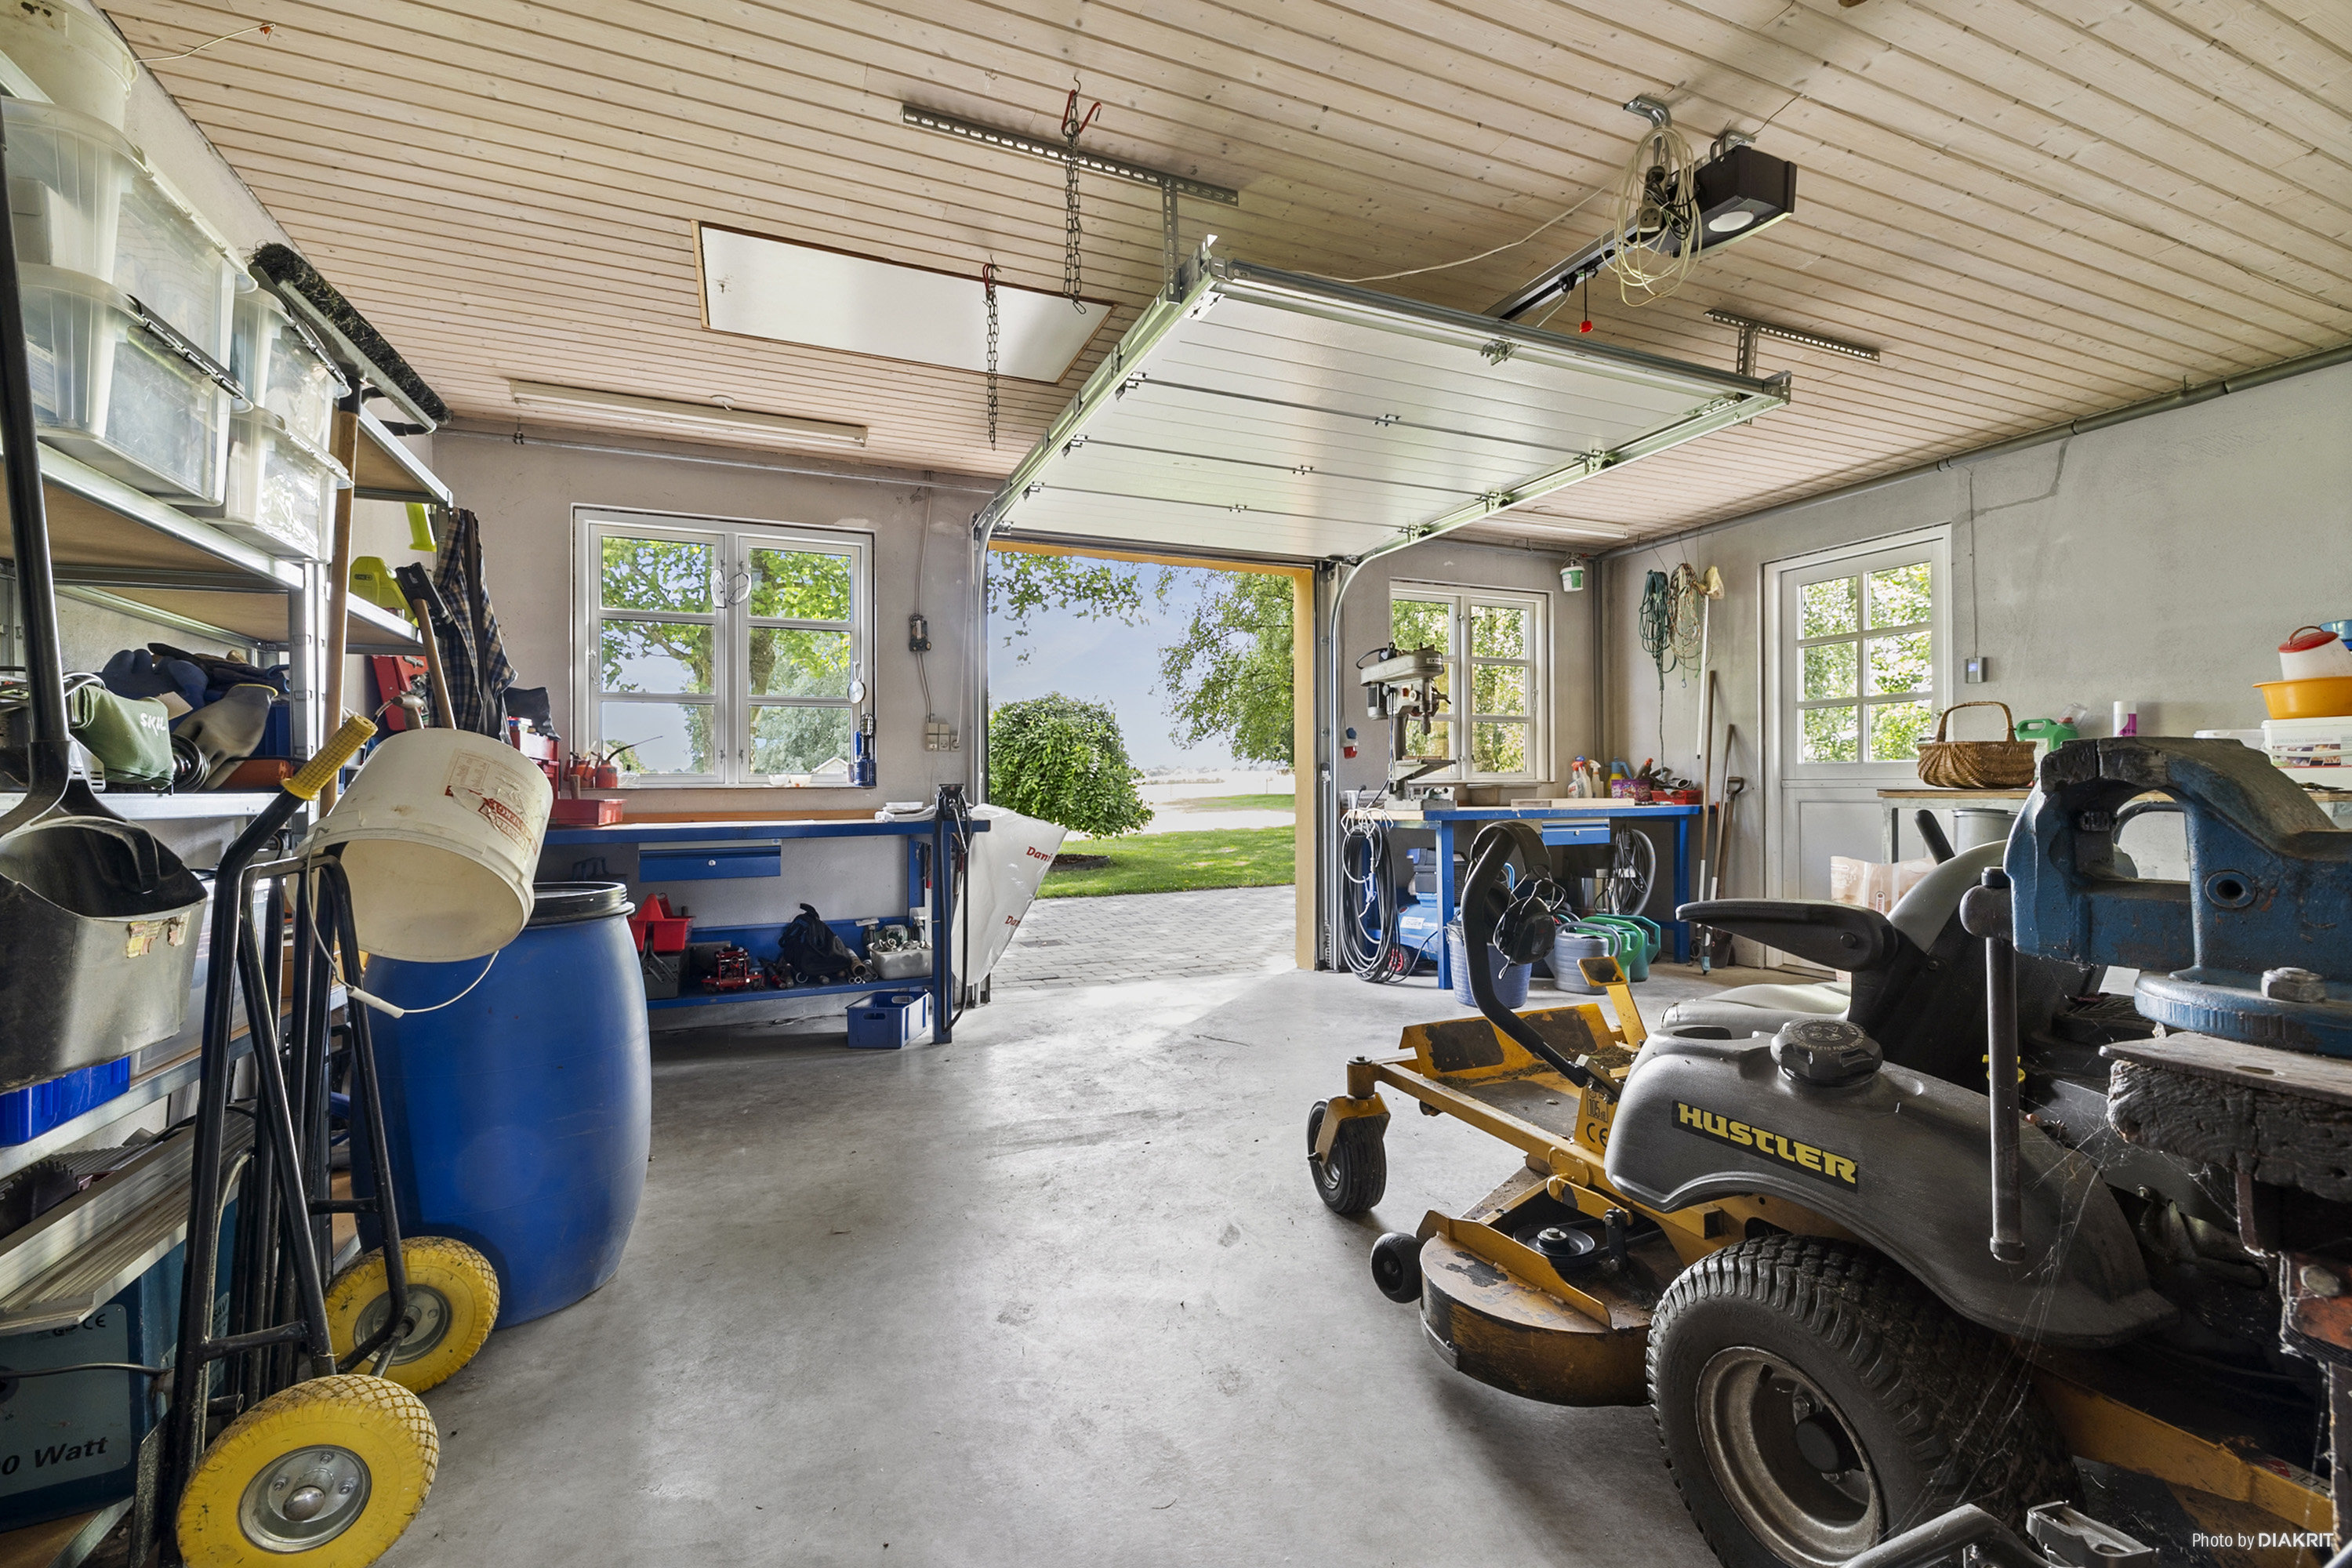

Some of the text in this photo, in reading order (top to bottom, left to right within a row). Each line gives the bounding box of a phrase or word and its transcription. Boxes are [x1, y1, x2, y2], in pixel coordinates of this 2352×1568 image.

[140, 713, 166, 737] SKIL
[1678, 1102, 1857, 1185] HUSTLER
[35, 1436, 108, 1468] Watt
